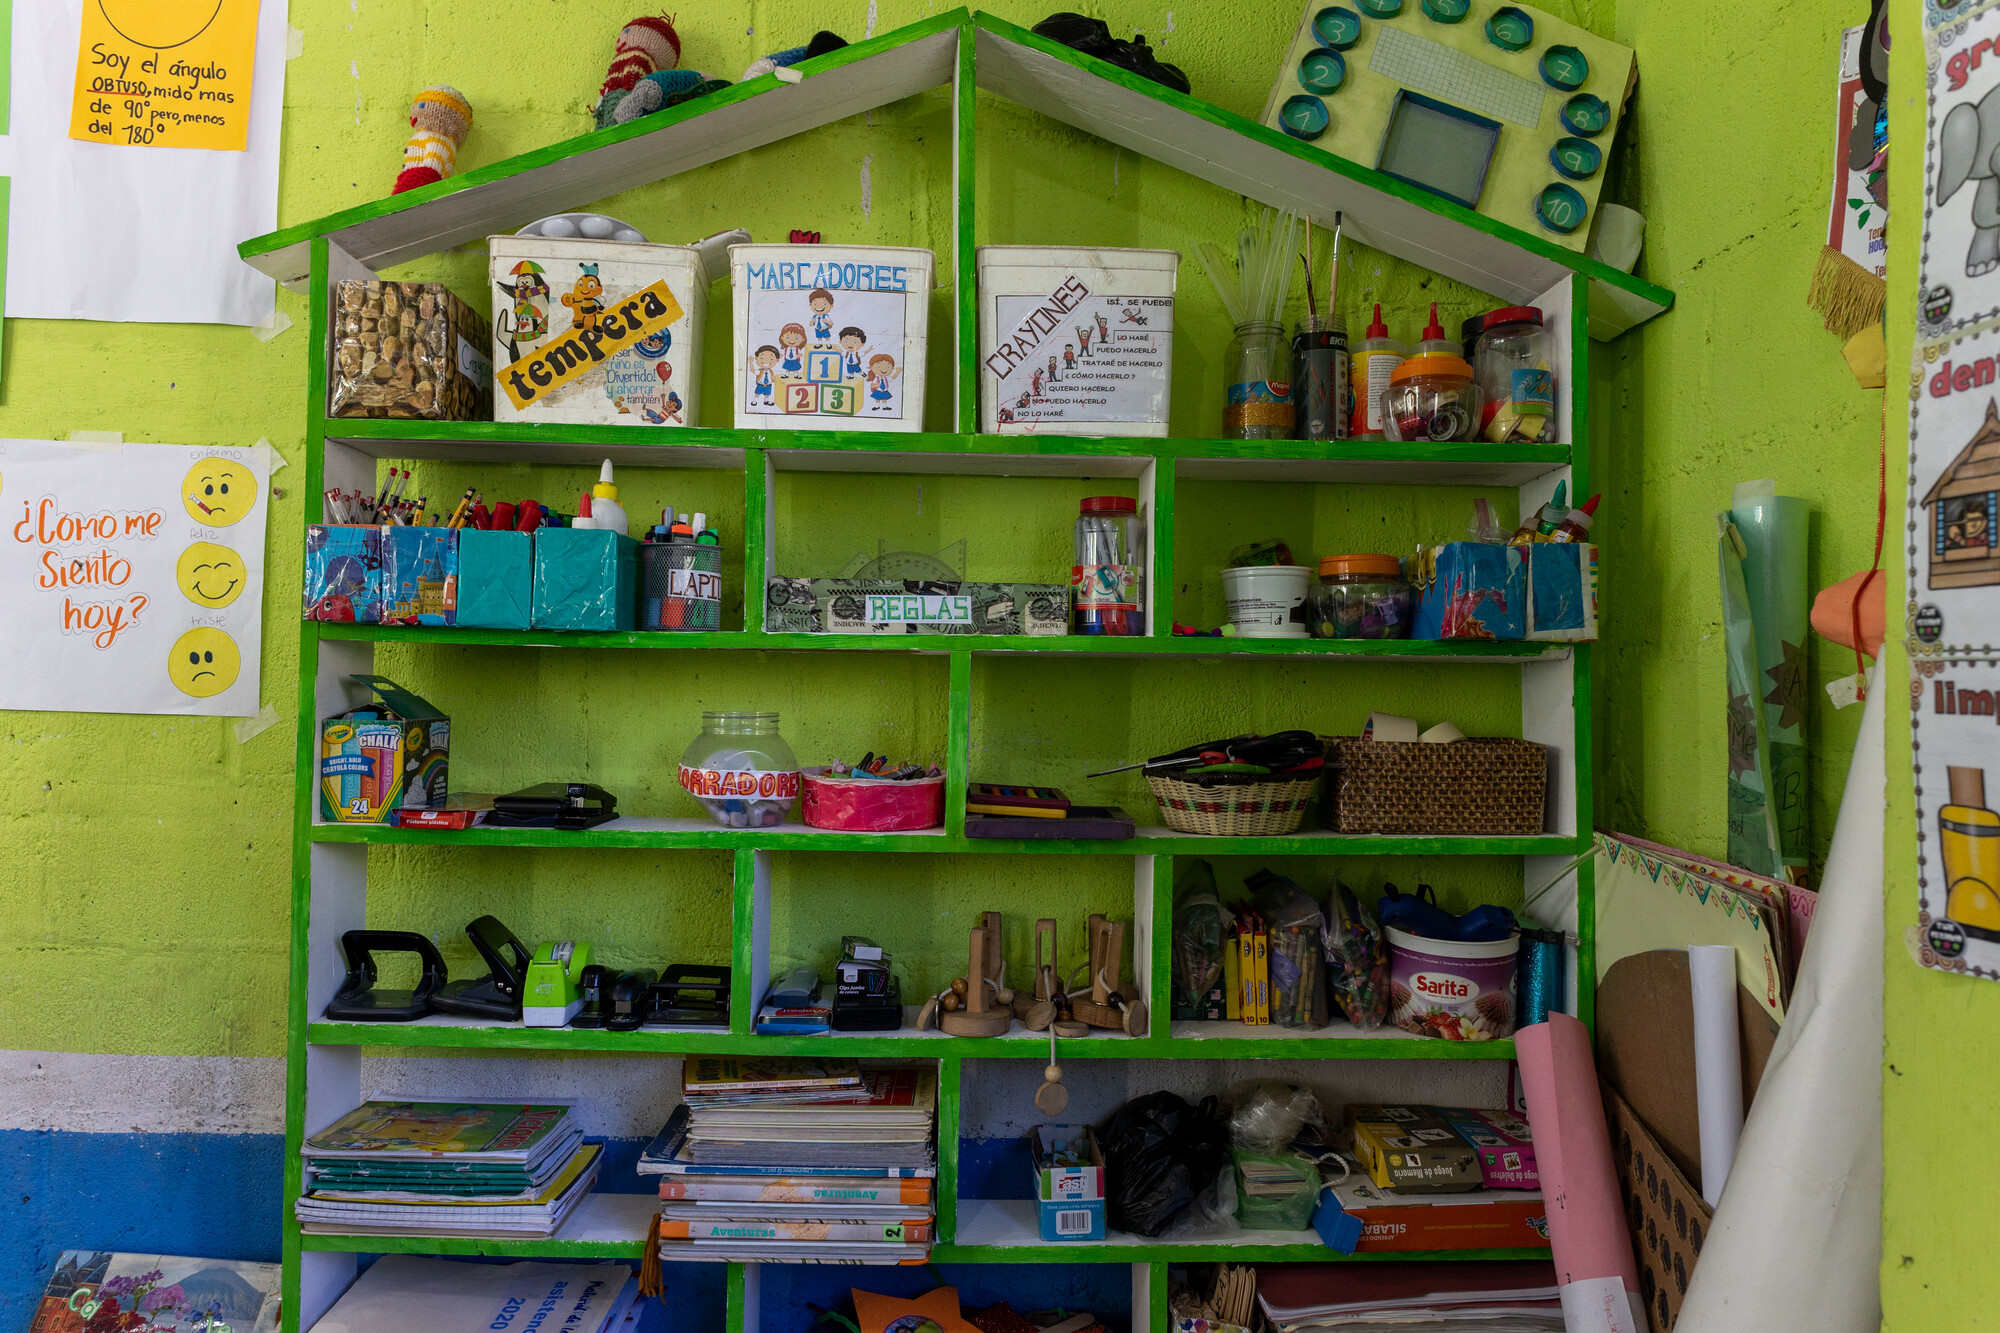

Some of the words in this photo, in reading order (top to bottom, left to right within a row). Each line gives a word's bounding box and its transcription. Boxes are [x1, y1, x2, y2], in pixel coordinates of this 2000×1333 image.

[1329, 20, 1346, 43] 3
[1495, 24, 1514, 40] 6
[91, 43, 130, 79] Soy
[141, 53, 158, 75] el
[168, 60, 227, 90] ángulo
[1314, 64, 1329, 87] 2
[1556, 60, 1572, 82] 7
[90, 98, 112, 115] de
[199, 89, 235, 104] mas
[1295, 110, 1310, 130] 1
[1574, 109, 1590, 129] 8
[88, 119, 112, 136] del
[122, 123, 165, 146] 180°
[1564, 151, 1582, 172] 9
[1546, 197, 1573, 226] 10
[747, 261, 907, 291] MARCADORES
[985, 275, 1090, 380] CRAYONES
[1129, 333, 1149, 341] HARÉ
[509, 291, 667, 400] tempera
[610, 359, 631, 370] niño
[633, 361, 645, 370] es
[819, 357, 830, 379] 1
[1081, 359, 1115, 367] TRATARÉ
[607, 368, 657, 384] Divertido!
[607, 385, 613, 399] y
[616, 380, 656, 395] ahorrar
[626, 394, 661, 404] también
[795, 387, 810, 410] 2
[830, 389, 844, 411] 3
[125, 512, 161, 537] me
[39, 549, 131, 588] Siento
[869, 597, 969, 622] REGLAS
[64, 595, 147, 649] hoy?
[1934, 680, 2000, 726] lim
[359, 734, 400, 750] CHALK
[322, 764, 348, 773] CRAYOLA
[351, 799, 369, 815] 24
[1416, 975, 1468, 997] Sarita
[495, 1110, 561, 1149] Victoria
[1394, 1168, 1422, 1179] Memoria
[1423, 1168, 1433, 1177] de
[1434, 1166, 1453, 1178] Juego
[1490, 1171, 1514, 1181] Deletreo
[1515, 1172, 1523, 1181] de
[814, 1189, 878, 1200] Aventuras
[711, 1226, 776, 1237] Aventuras
[885, 1226, 901, 1238] 2
[490, 1297, 526, 1331] 2020
